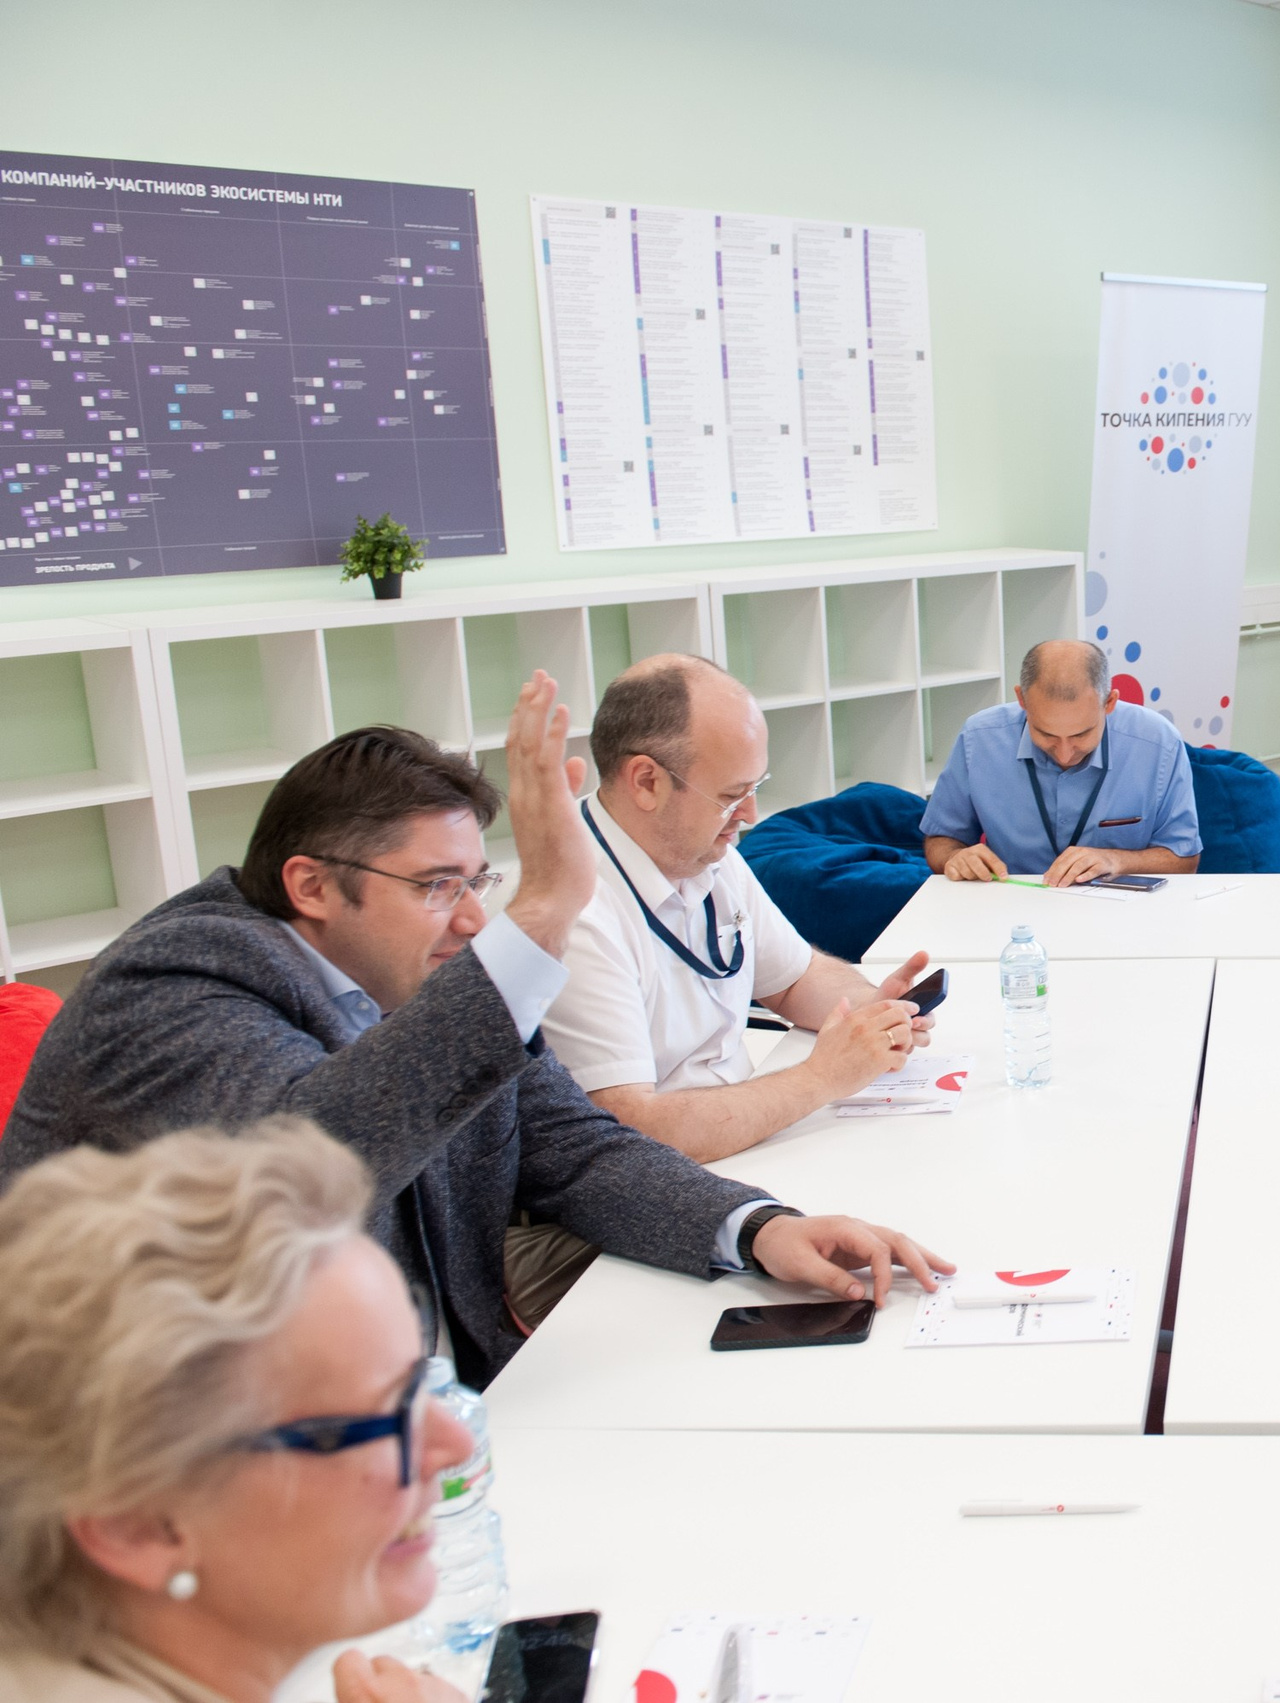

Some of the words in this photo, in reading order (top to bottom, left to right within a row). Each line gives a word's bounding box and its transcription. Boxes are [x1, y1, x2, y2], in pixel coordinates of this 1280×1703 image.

[210, 185, 310, 205] ЭКОСИСТЕМЫ
[313, 193, 343, 207] НТИ
[1101, 412, 1152, 428] ТОЧКА
[1156, 412, 1225, 428] КИПЕНИЯ
[1228, 412, 1252, 428] ГУУ
[35, 564, 74, 574] ЗРЕЛОСТЬ
[75, 562, 116, 571] ПРОДУКТА
